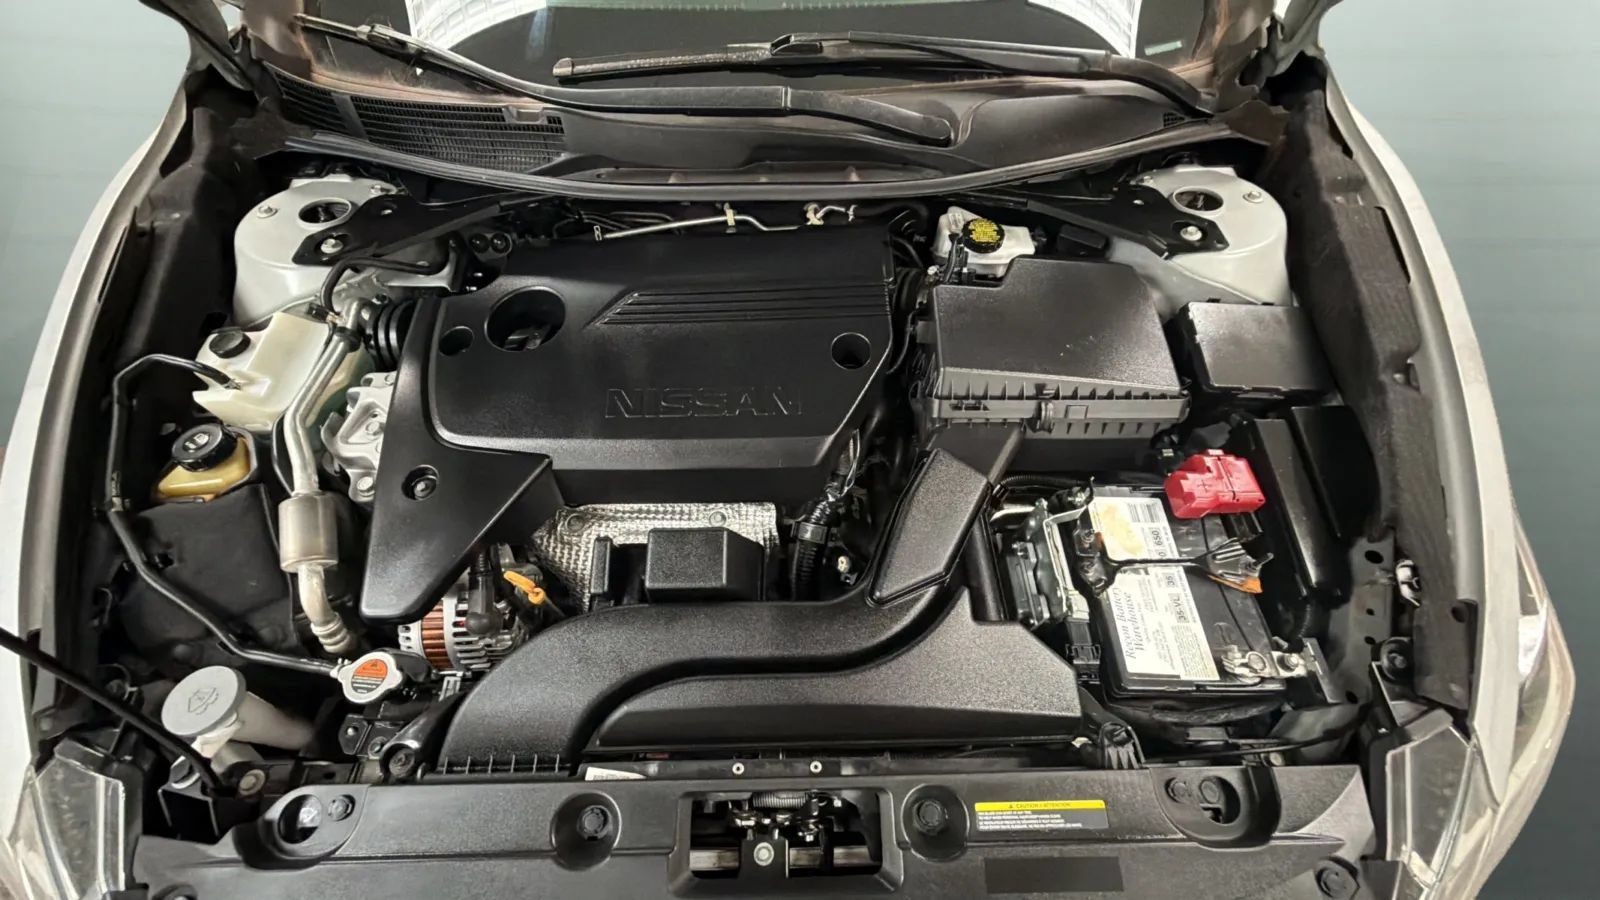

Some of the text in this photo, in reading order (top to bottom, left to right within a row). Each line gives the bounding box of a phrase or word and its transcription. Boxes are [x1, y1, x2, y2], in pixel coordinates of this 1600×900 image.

[605, 386, 802, 418] NISSAN
[1151, 530, 1163, 546] 650
[1165, 575, 1175, 586] 35
[1123, 592, 1145, 651] Warehouse
[1172, 596, 1187, 621] 35-VL
[1111, 587, 1137, 659] Recon Battery
